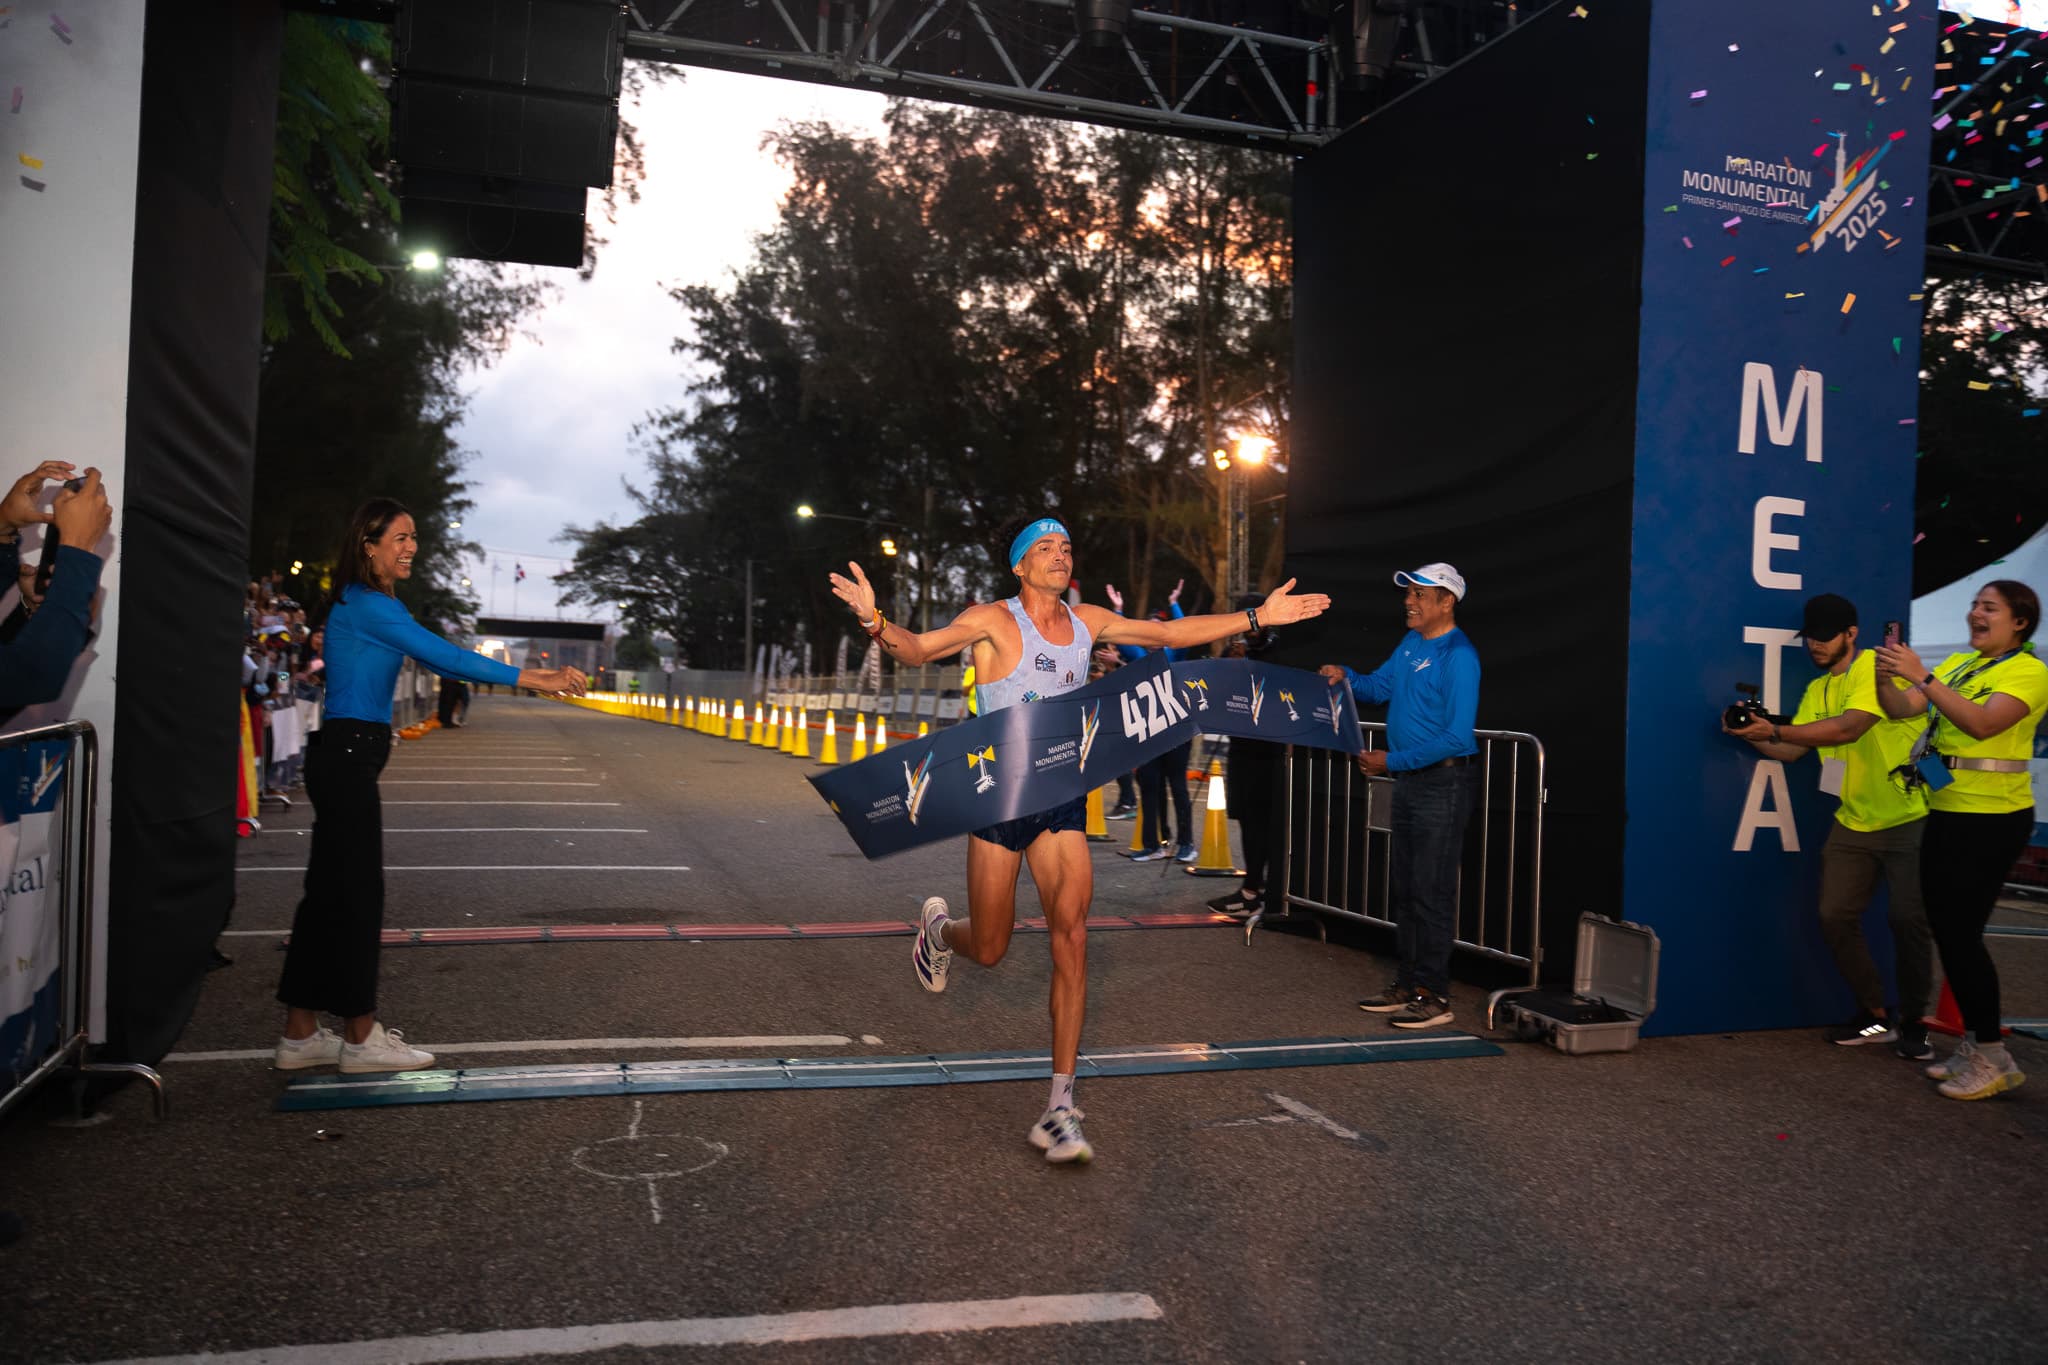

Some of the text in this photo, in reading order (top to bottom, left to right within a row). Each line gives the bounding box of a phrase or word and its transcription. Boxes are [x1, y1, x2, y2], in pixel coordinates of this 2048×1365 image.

[1682, 169, 1810, 210] MONUMENTAL
[1682, 193, 1715, 208] PRIMER
[1716, 200, 1758, 217] SANTIAGO
[1759, 207, 1771, 219] DE
[1836, 191, 1887, 253] 2025
[1732, 361, 1824, 852] META
[1120, 669, 1189, 743] 42K
[1035, 749, 1078, 768] MONUMENTAL
[1047, 740, 1076, 755] MARATON
